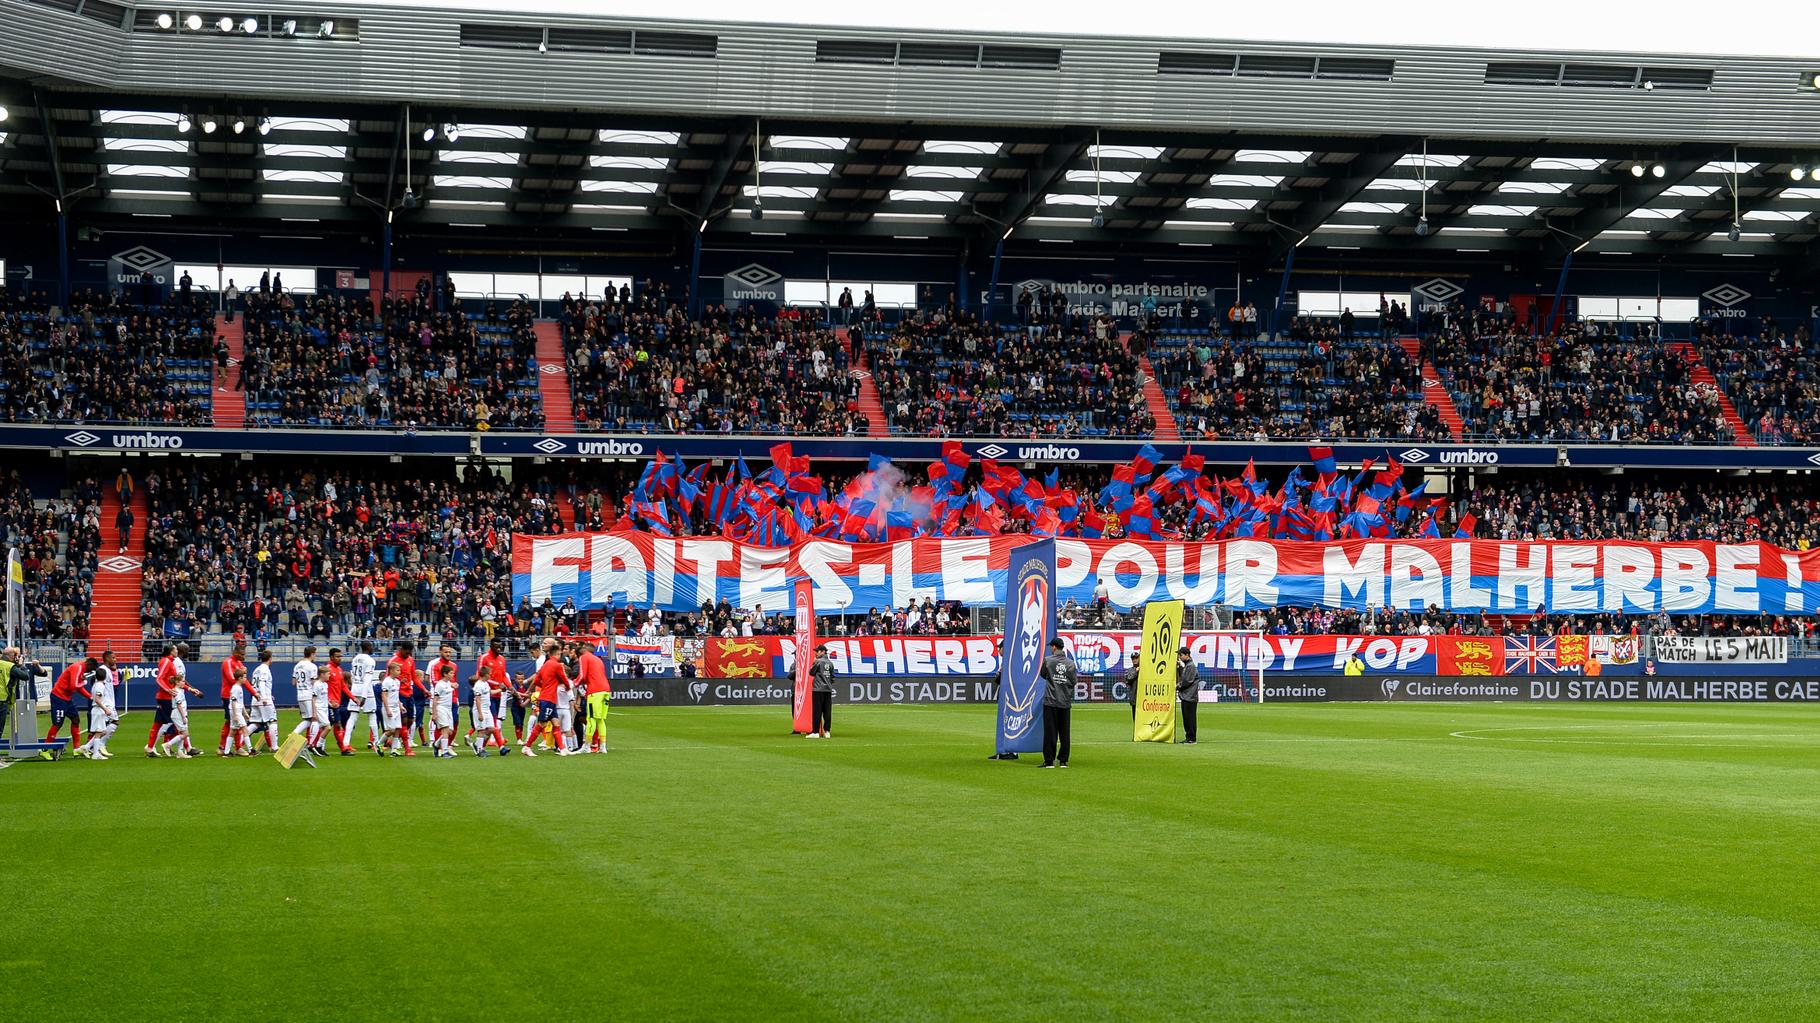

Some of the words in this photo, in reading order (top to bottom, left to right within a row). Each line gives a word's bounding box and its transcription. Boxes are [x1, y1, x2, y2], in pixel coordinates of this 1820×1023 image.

[341, 278, 350, 288] 3
[1051, 279, 1106, 295] umbro
[1111, 281, 1208, 299] partenaire
[732, 289, 776, 301] umbro
[1066, 300, 1104, 316] tade
[112, 432, 183, 449] umbro
[577, 439, 643, 455] umbro
[1018, 444, 1080, 460] umbro
[1439, 449, 1499, 464] umbro
[530, 535, 996, 610] FAITES-LE
[1037, 537, 1280, 608] POUR
[1322, 542, 1760, 611] MALHERBE
[1657, 637, 1677, 647] PAS
[1682, 637, 1695, 648] DE
[1705, 638, 1723, 661] LE
[1727, 637, 1740, 660] 5
[1745, 637, 1784, 660] MAI!
[1333, 637, 1429, 670] KOP
[1658, 647, 1697, 661] MATCH
[850, 682, 882, 701] DU
[889, 682, 966, 701] STADE
[1145, 684, 1165, 697] LIGUE
[1406, 682, 1519, 698] Clairefontaine
[1530, 681, 1560, 700] DU
[1567, 681, 1640, 700] STADE
[1646, 680, 1768, 700] MALHERBE
[56, 709, 64, 718] 11
[1142, 698, 1171, 713] Conforama
